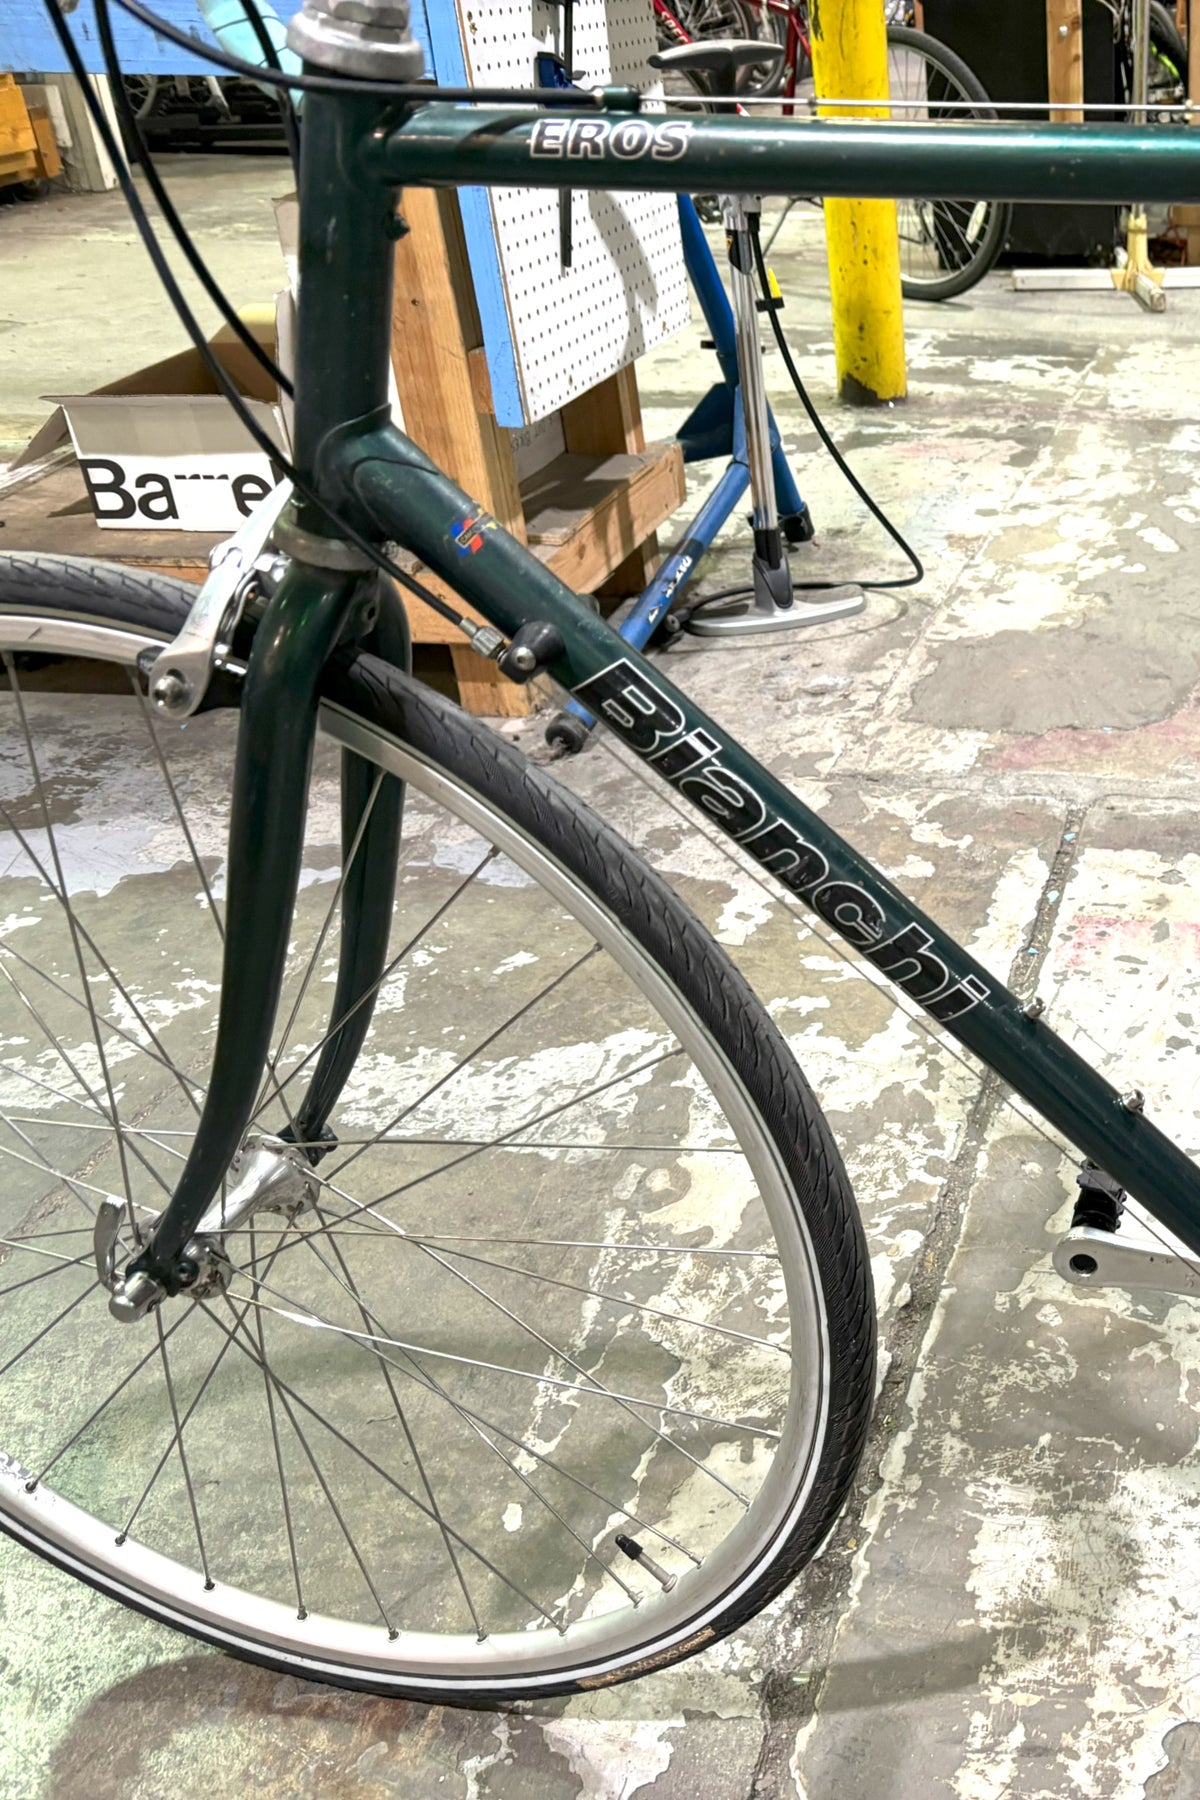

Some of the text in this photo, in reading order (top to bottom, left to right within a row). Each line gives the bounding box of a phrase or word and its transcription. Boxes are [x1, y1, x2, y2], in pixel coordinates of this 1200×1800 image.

[530, 118, 694, 161] EROS
[77, 459, 285, 521] Bae
[572, 657, 990, 1022] Bianchi
